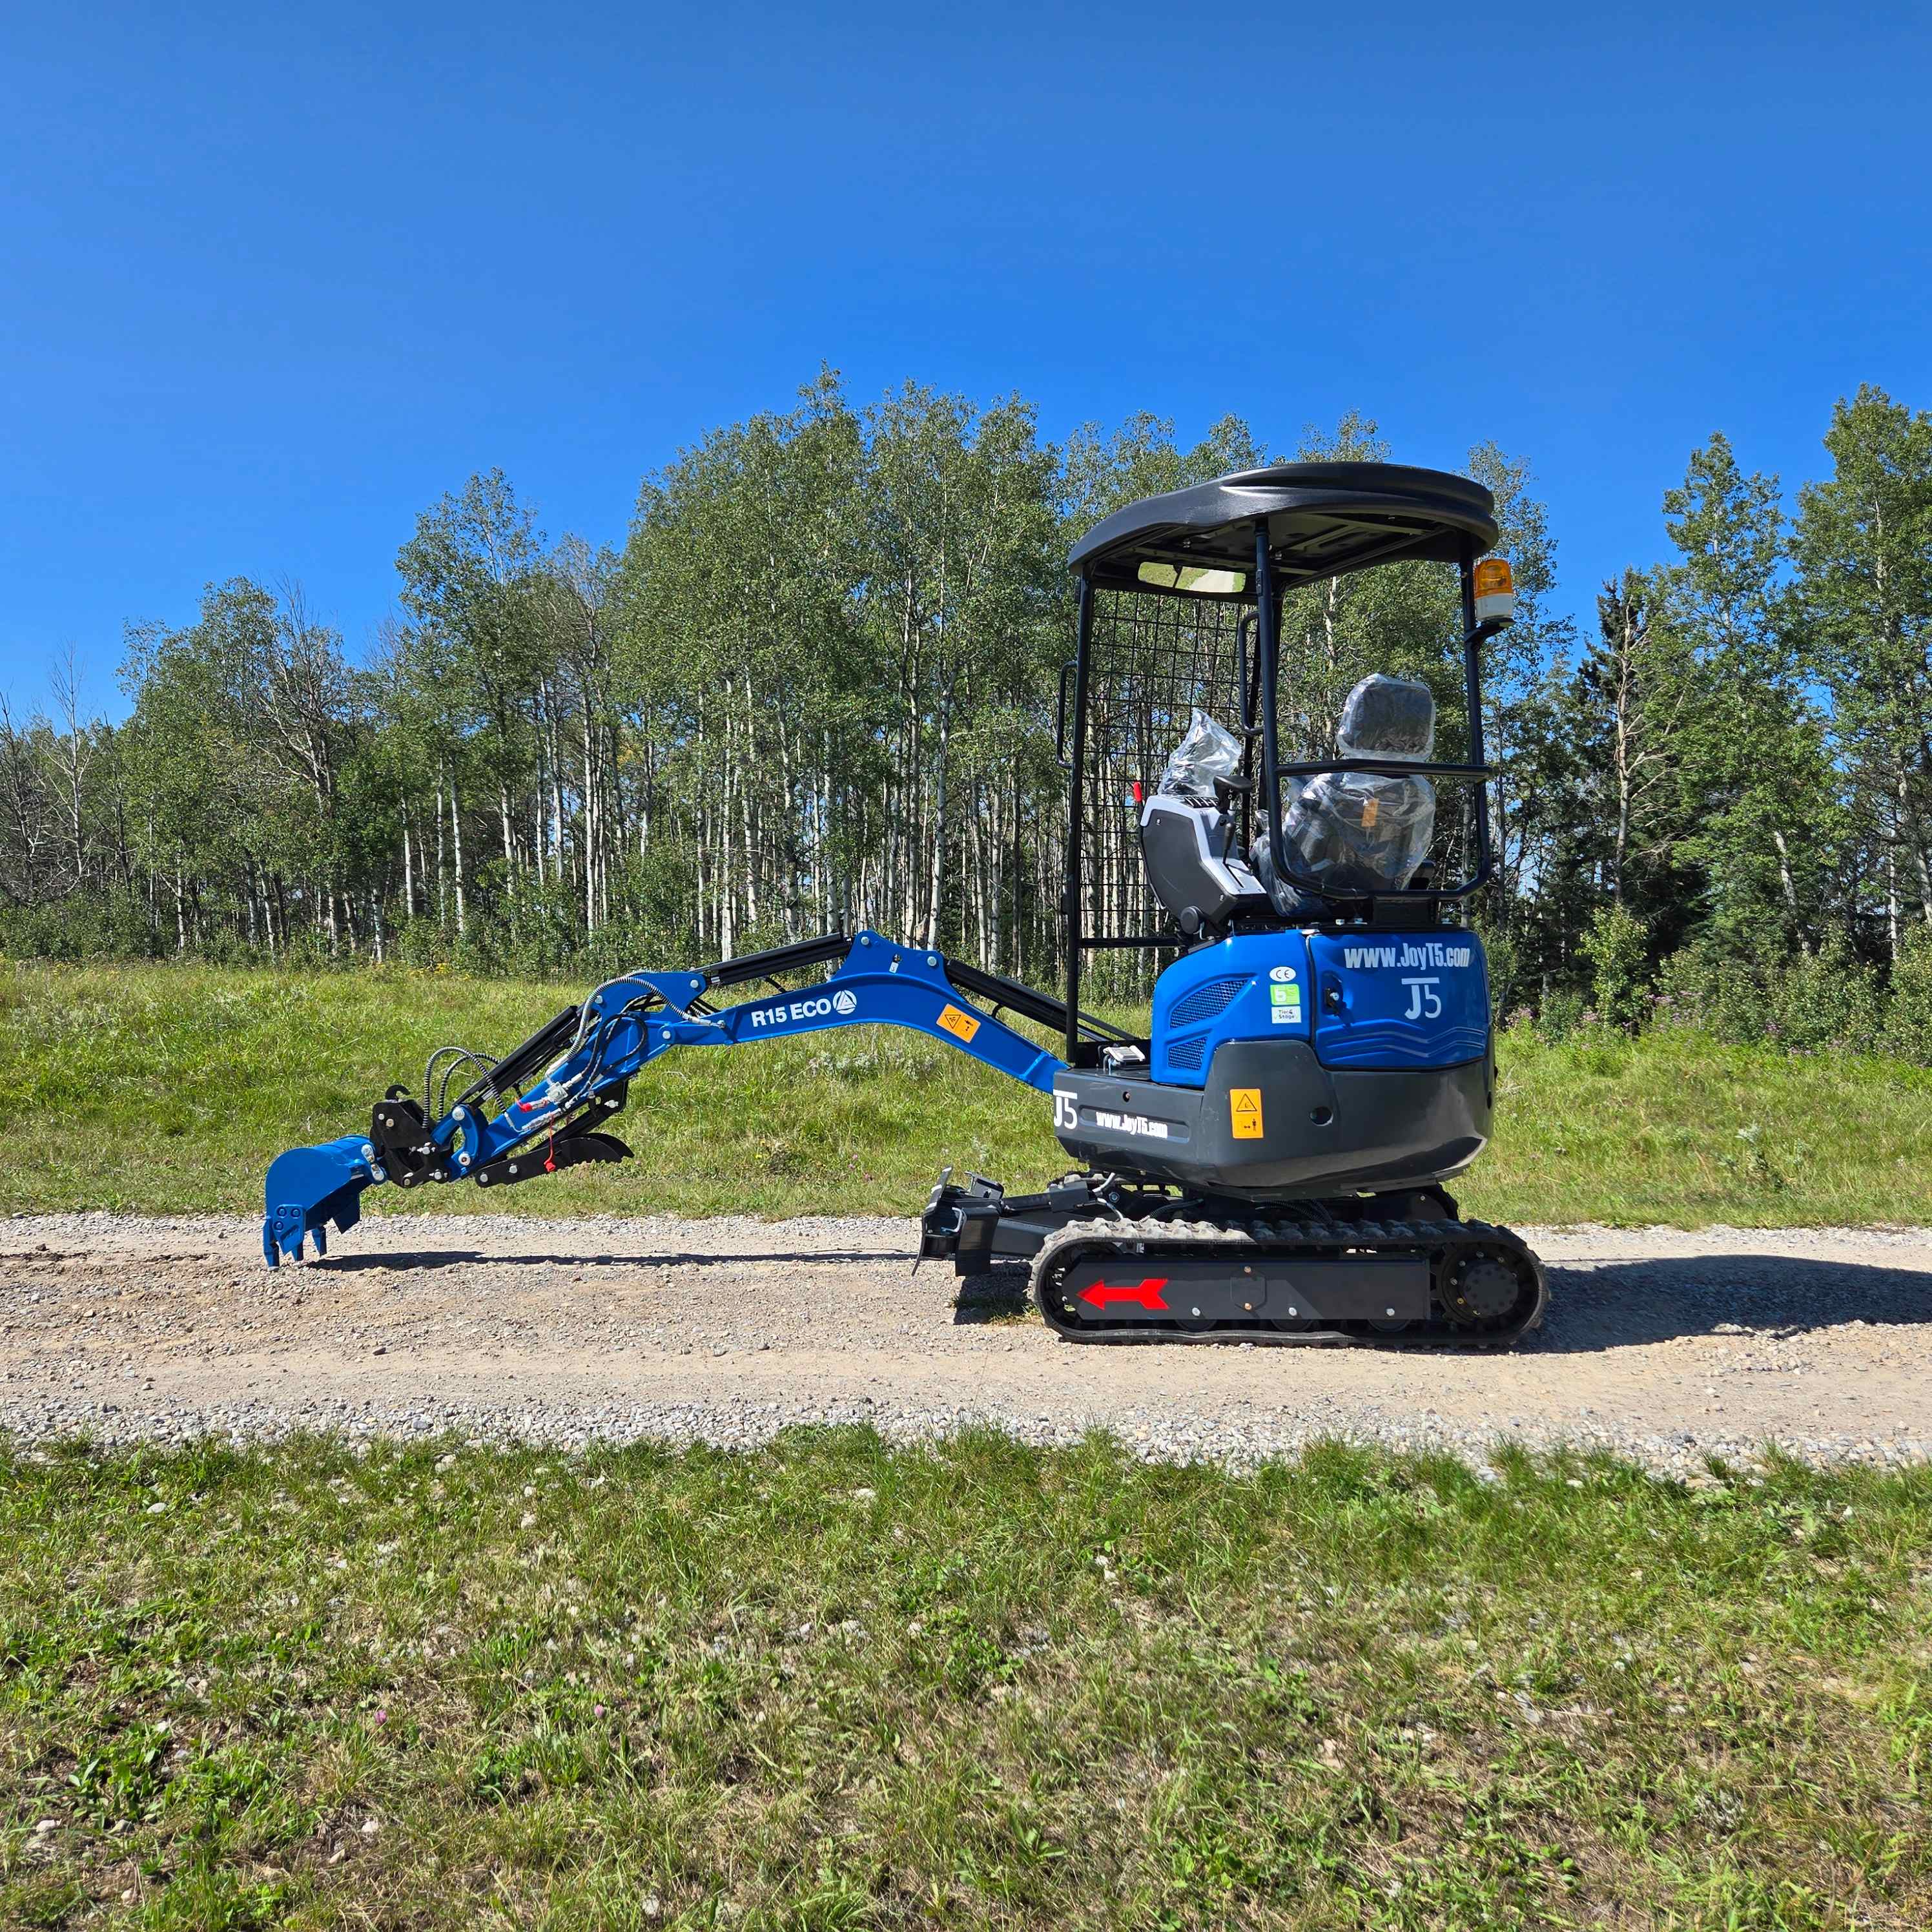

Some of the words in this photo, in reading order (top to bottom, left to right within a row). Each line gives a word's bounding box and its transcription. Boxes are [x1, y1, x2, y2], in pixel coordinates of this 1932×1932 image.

[1344, 943, 1470, 970] www.JoyT5.com
[1276, 969, 1290, 979] CE
[751, 1006, 787, 1027] R15
[790, 998, 832, 1020] ECO
[1401, 977, 1442, 1020] J5
